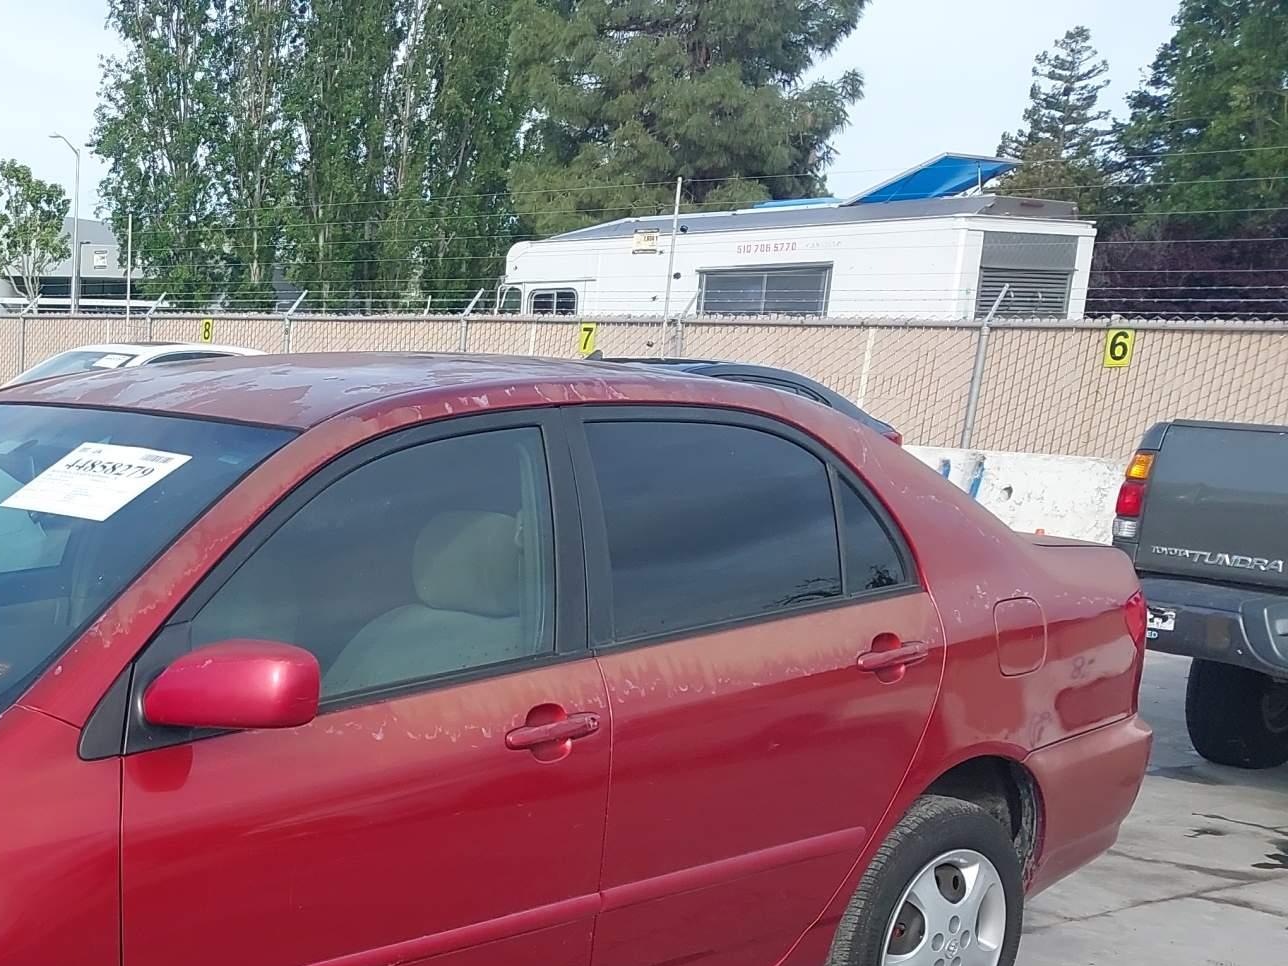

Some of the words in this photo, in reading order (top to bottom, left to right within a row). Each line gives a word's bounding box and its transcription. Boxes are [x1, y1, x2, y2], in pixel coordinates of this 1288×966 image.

[736, 244, 752, 254] 510
[773, 241, 797, 252] 5770
[203, 321, 211, 340] 8
[582, 327, 594, 350] 7
[1109, 331, 1129, 361] 6
[65, 457, 156, 479] 44858279
[1151, 545, 1190, 558] TOYOTA
[1188, 550, 1285, 573] TUNDRA
